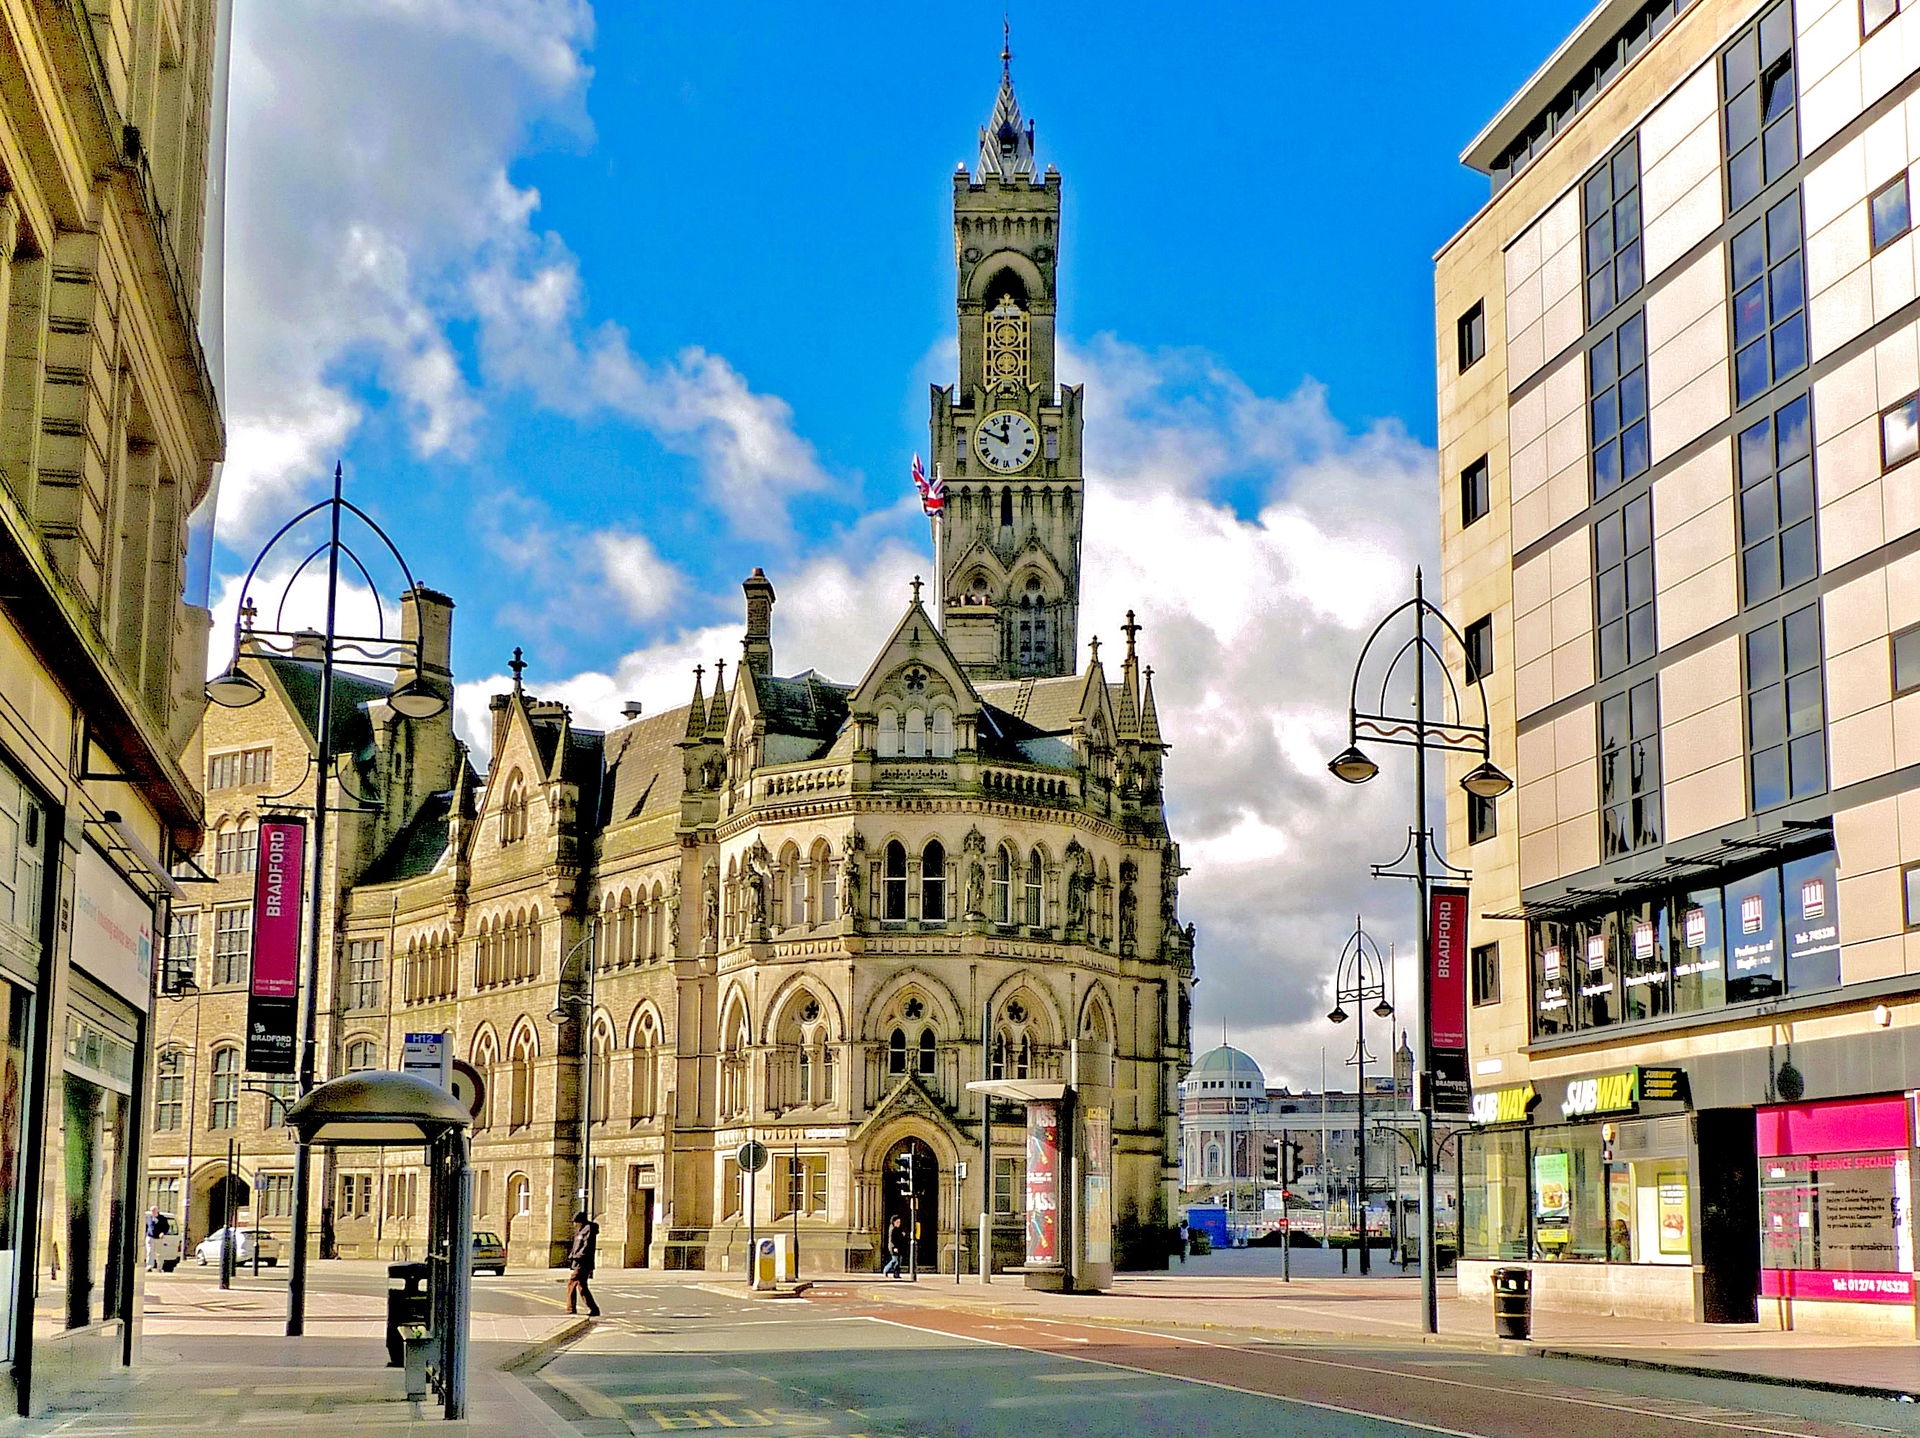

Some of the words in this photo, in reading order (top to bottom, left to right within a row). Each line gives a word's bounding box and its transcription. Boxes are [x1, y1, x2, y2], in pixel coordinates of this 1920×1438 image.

[266, 831, 285, 917] BRADFORD
[1438, 901, 1451, 978] BRADFORD
[251, 1034, 292, 1043] BRADFORD
[412, 1034, 434, 1043] H12
[1468, 1083, 1535, 1124] SUBWAY
[1562, 1073, 1635, 1116] SUBWAY
[1832, 1278, 1848, 1291] Tel:
[1848, 1278, 1875, 1292] 01274
